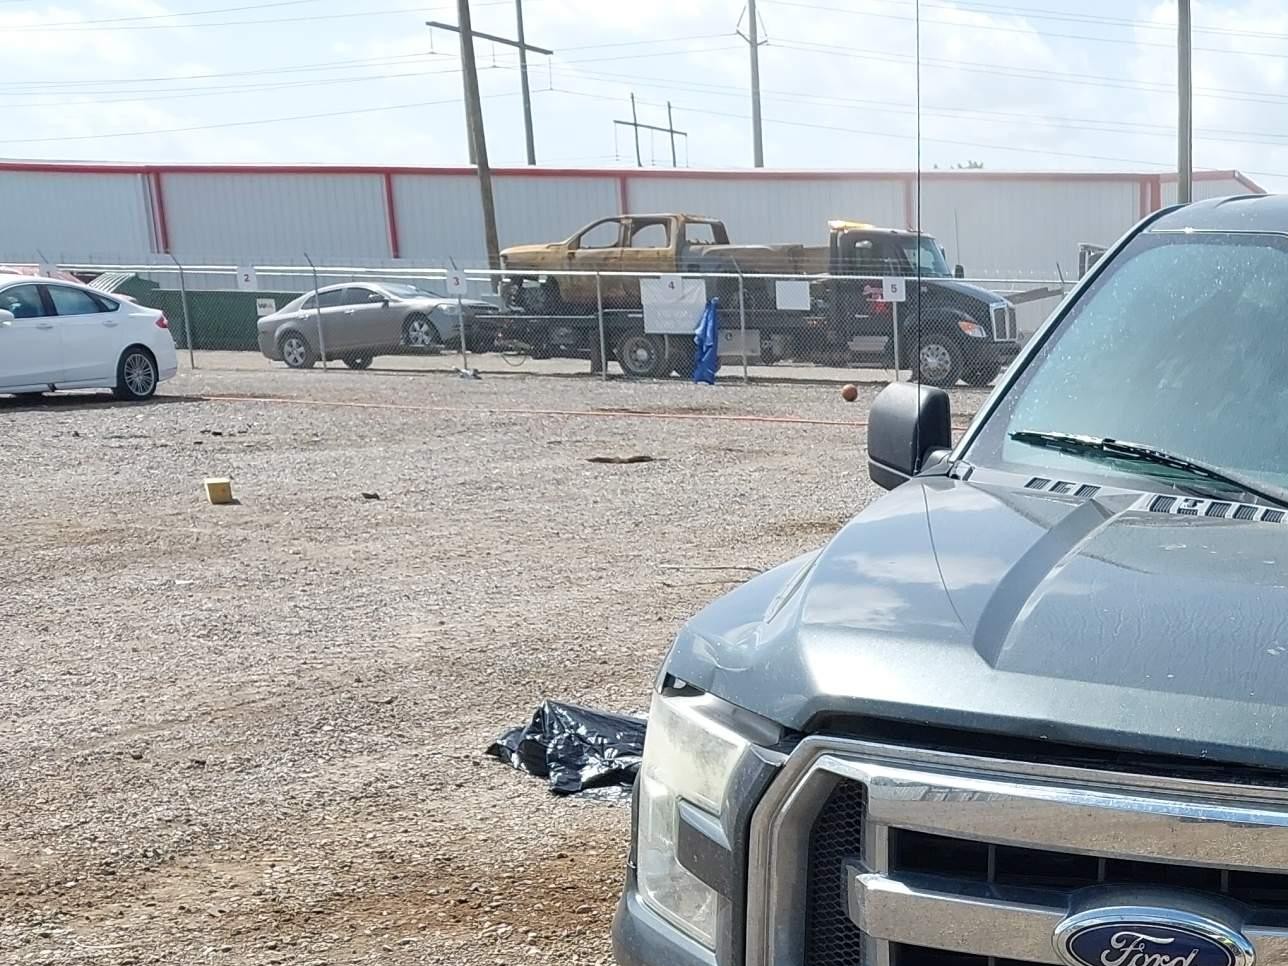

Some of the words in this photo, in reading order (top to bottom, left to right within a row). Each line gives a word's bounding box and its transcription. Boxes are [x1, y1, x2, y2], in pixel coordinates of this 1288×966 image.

[243, 273, 251, 282] 2
[452, 276, 460, 286] 3
[667, 280, 676, 291] 4
[890, 284, 898, 294] 5
